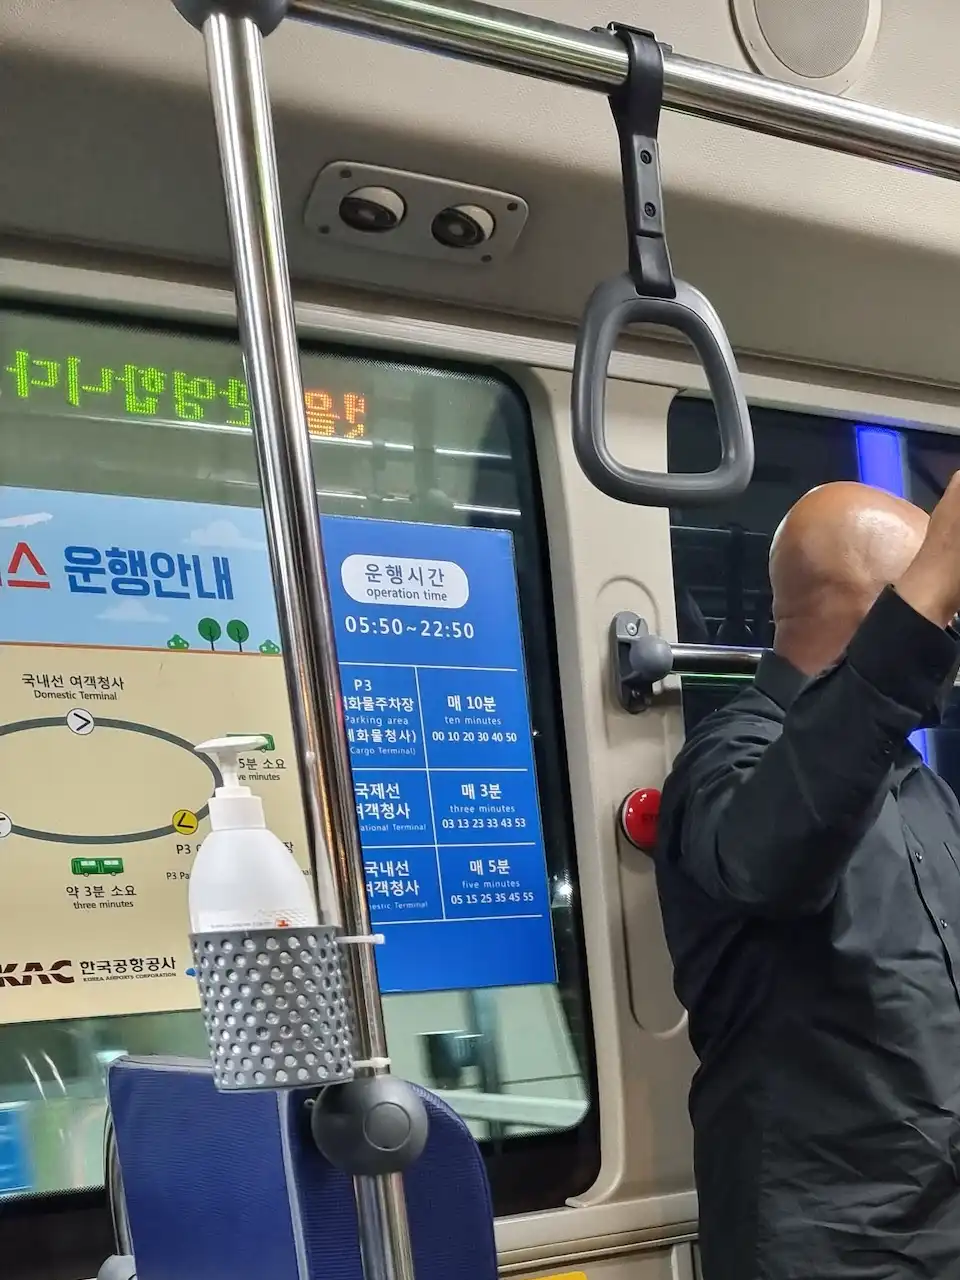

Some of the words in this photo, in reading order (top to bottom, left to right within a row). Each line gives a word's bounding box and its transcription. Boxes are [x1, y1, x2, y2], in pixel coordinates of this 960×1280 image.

[0, 541, 50, 590] 스
[64, 546, 234, 600] 운행안내
[364, 563, 445, 588] 운행시간
[366, 587, 420, 600] operation
[423, 589, 448, 602] time
[21, 673, 65, 688] 국내선
[69, 675, 125, 691] 여객청사
[354, 679, 372, 692] P3
[33, 689, 77, 700] Domestic
[79, 690, 118, 701] Terminal
[343, 696, 414, 712] 화물주차장
[447, 695, 462, 711] 매
[466, 696, 497, 712] 10분
[387, 717, 409, 725] area
[444, 716, 461, 725] ten
[465, 716, 502, 725] minutes
[432, 731, 445, 741] 00
[447, 732, 460, 741] 10
[463, 732, 475, 742] 20
[477, 732, 489, 742] 30
[491, 732, 504, 742] 40
[505, 732, 517, 742] 50
[238, 758, 258, 771] 5분
[263, 758, 287, 770] 소요
[248, 772, 281, 781] minutes
[354, 782, 401, 800] 국제선
[461, 783, 476, 800] 매
[480, 783, 502, 800] 3분
[449, 804, 475, 813] three
[478, 804, 516, 813] minutes
[360, 824, 389, 832] ational
[392, 824, 427, 832] Terminal
[442, 819, 455, 829] 03
[457, 819, 470, 829] 13
[472, 819, 484, 828] 23
[486, 818, 499, 828] 33
[501, 818, 513, 828] 43
[515, 817, 526, 828] 53
[176, 844, 191, 855] P3
[364, 860, 410, 878] 국내선
[469, 859, 484, 876] 매
[488, 859, 511, 875] 5분
[166, 871, 177, 880] P3
[462, 880, 480, 889] five
[483, 880, 520, 889] minutes
[66, 886, 80, 900] 약
[84, 886, 106, 899] 3분
[111, 885, 138, 897] 소요
[450, 895, 463, 905] 05
[466, 894, 478, 904] 15
[480, 894, 492, 903] 25
[494, 893, 507, 903] 35
[508, 892, 521, 902] 45
[522, 891, 534, 902] 55
[73, 901, 97, 910] three
[99, 899, 134, 909] minutes
[370, 902, 392, 910] estic
[394, 900, 428, 910] Terminal
[79, 956, 177, 976] 한국공항공사
[0, 960, 75, 988] KAC
